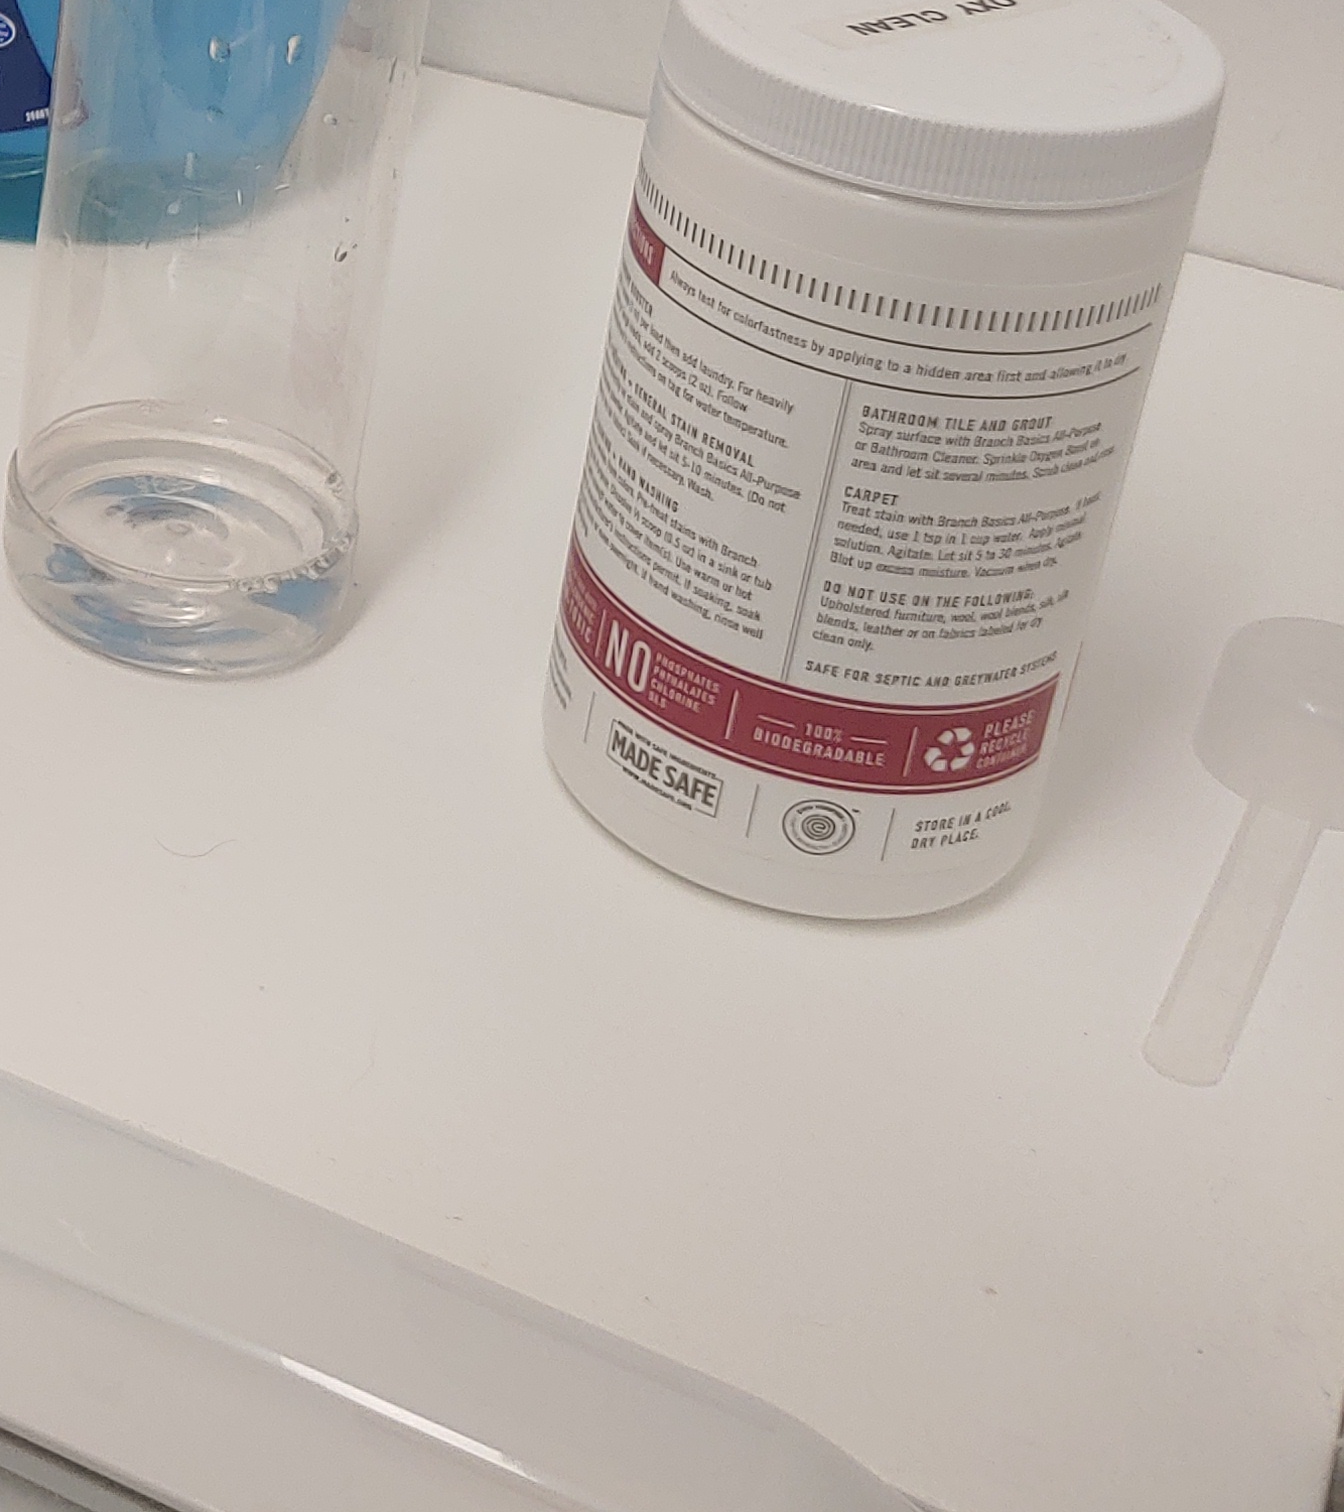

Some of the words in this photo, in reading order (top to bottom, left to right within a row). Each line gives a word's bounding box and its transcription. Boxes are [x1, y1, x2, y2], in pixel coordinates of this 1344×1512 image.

[846, 10, 948, 35] CLEAN
[718, 300, 732, 317] for
[733, 310, 807, 349] colorfastness
[811, 340, 825, 356] by
[827, 346, 883, 371] applying
[888, 359, 900, 372] to
[902, 364, 912, 374] a
[915, 363, 960, 381] hidden
[964, 371, 992, 383] area
[996, 369, 1022, 384] first
[1025, 368, 1046, 382] and
[862, 405, 939, 429] BATHROOM
[945, 417, 975, 431] TILE
[979, 418, 1007, 432] AND
[1011, 416, 1053, 431] GROUT
[671, 413, 699, 440] STAIN
[702, 432, 755, 468] REMOVAL
[844, 486, 900, 507] CARPET
[823, 580, 841, 594] DO
[847, 584, 874, 602] NOT
[879, 591, 906, 606] USE
[912, 595, 930, 608] ON
[936, 595, 959, 608] THE
[963, 588, 1034, 608] FOLLOWING:
[605, 619, 652, 693] NO
[656, 652, 720, 693] PHOSPHATES
[805, 660, 839, 678] SAFE
[844, 668, 870, 683] FOR
[874, 672, 921, 687] SEPTIC
[926, 675, 950, 688] AND
[954, 667, 1018, 686] GREYWATER
[803, 722, 843, 743] 100%
[983, 709, 1034, 738] PLEASE
[753, 726, 885, 767] BIODEGRADABLE
[979, 729, 1028, 755] RECYCLE
[611, 730, 662, 781] MADE
[661, 765, 717, 807] SAFE
[914, 813, 954, 832] STORE
[958, 813, 972, 826] IN
[974, 811, 982, 823] A
[911, 836, 935, 850] DRY
